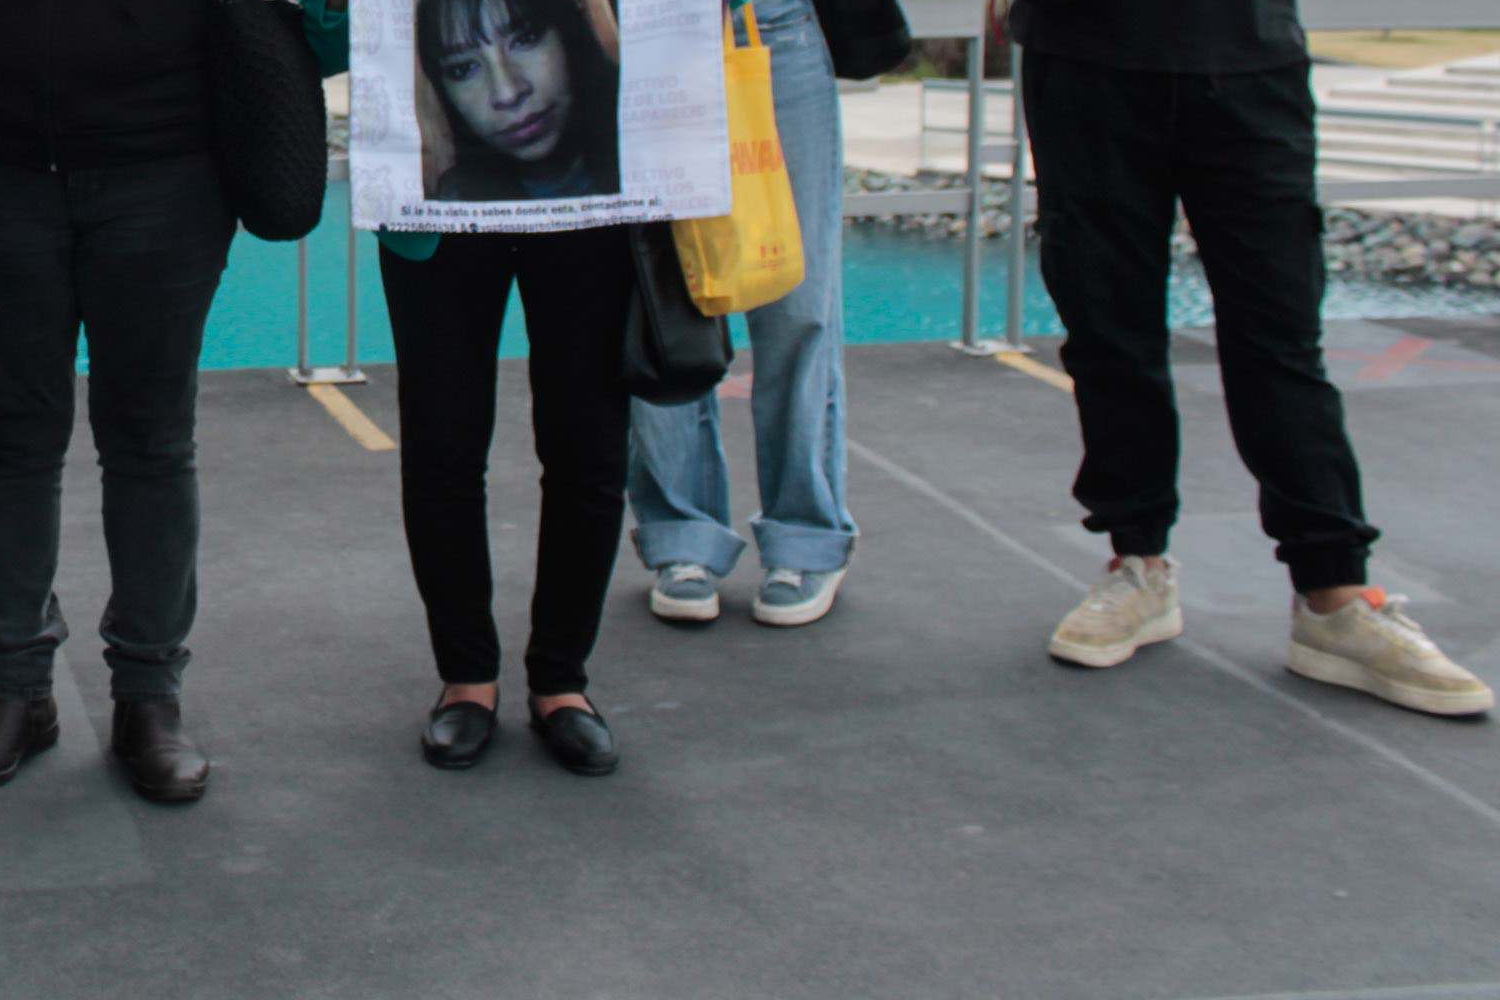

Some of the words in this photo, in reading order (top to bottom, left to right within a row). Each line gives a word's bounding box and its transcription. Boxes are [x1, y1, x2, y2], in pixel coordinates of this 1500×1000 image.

[400, 205, 411, 216] Si
[427, 206, 441, 216] ha
[515, 205, 548, 216] donde
[580, 199, 645, 213] contactarse
